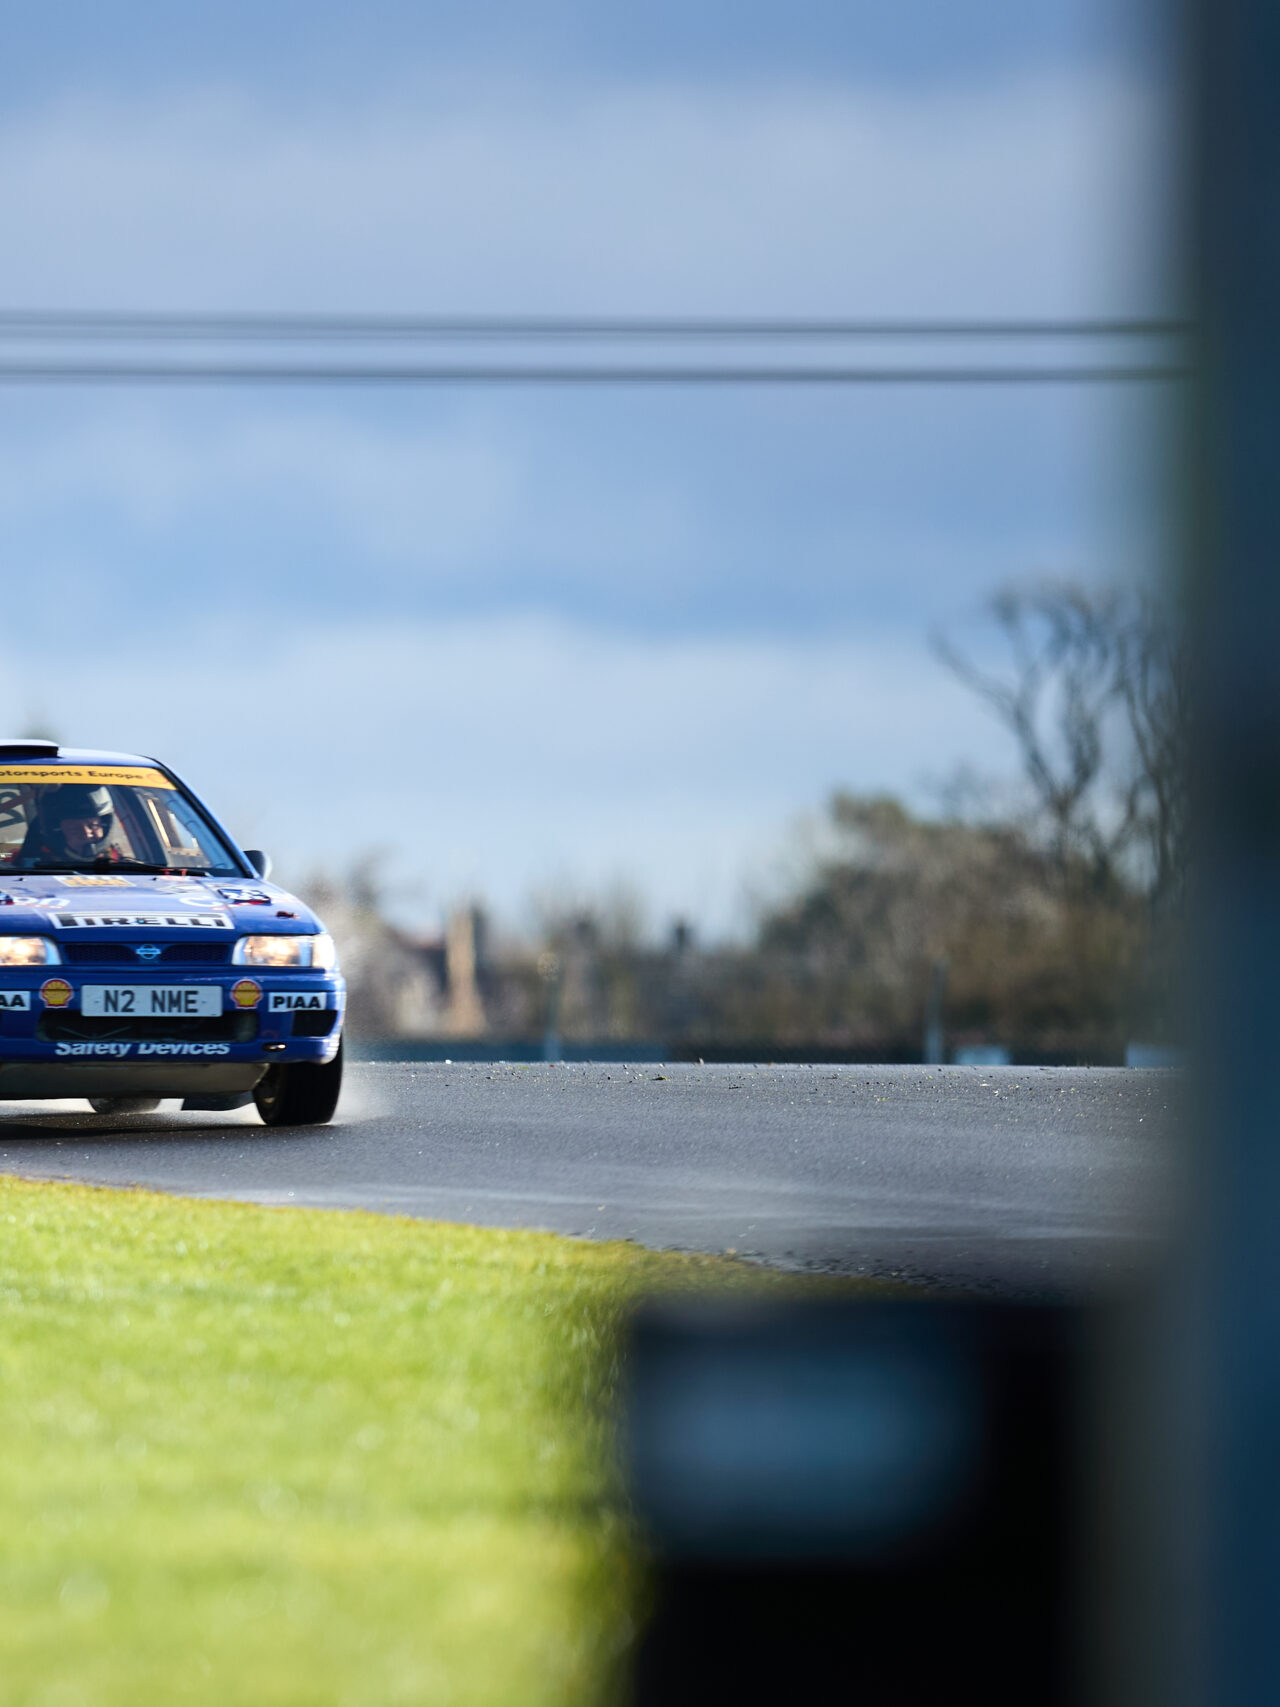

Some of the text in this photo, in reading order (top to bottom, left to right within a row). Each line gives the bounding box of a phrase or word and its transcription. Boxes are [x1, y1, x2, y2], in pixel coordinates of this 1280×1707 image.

[88, 770, 144, 780] Europe
[54, 913, 226, 928] PIRELLI
[104, 990, 199, 1013] N2 NME
[273, 996, 321, 1009] PIAA
[55, 1041, 231, 1058] Safety Devices
